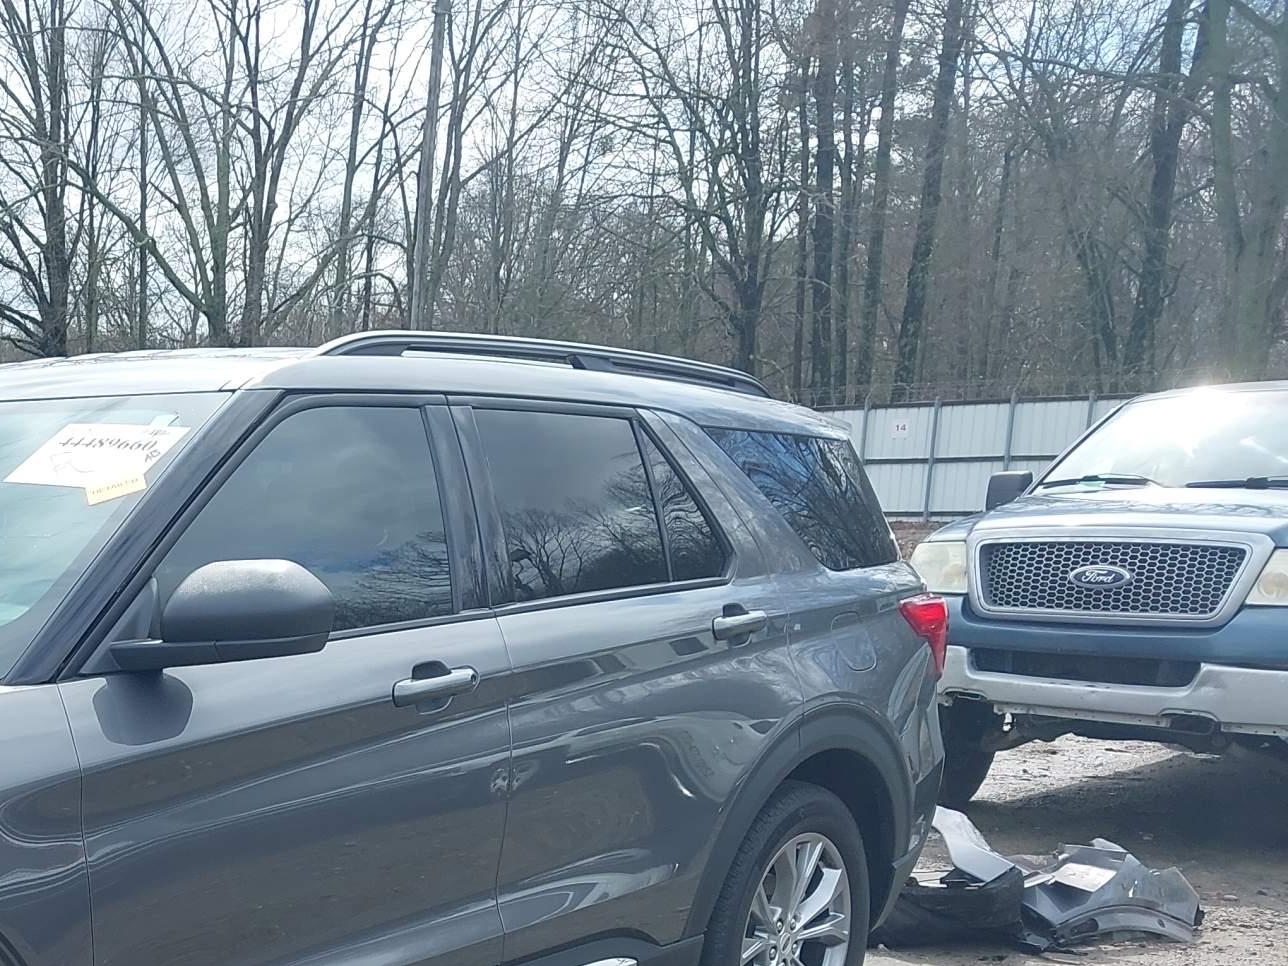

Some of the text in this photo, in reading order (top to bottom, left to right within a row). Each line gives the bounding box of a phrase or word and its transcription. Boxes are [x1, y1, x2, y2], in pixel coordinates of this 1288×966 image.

[896, 423, 906, 431] 14
[58, 437, 158, 451] 44489660
[1081, 569, 1116, 583] Ford
